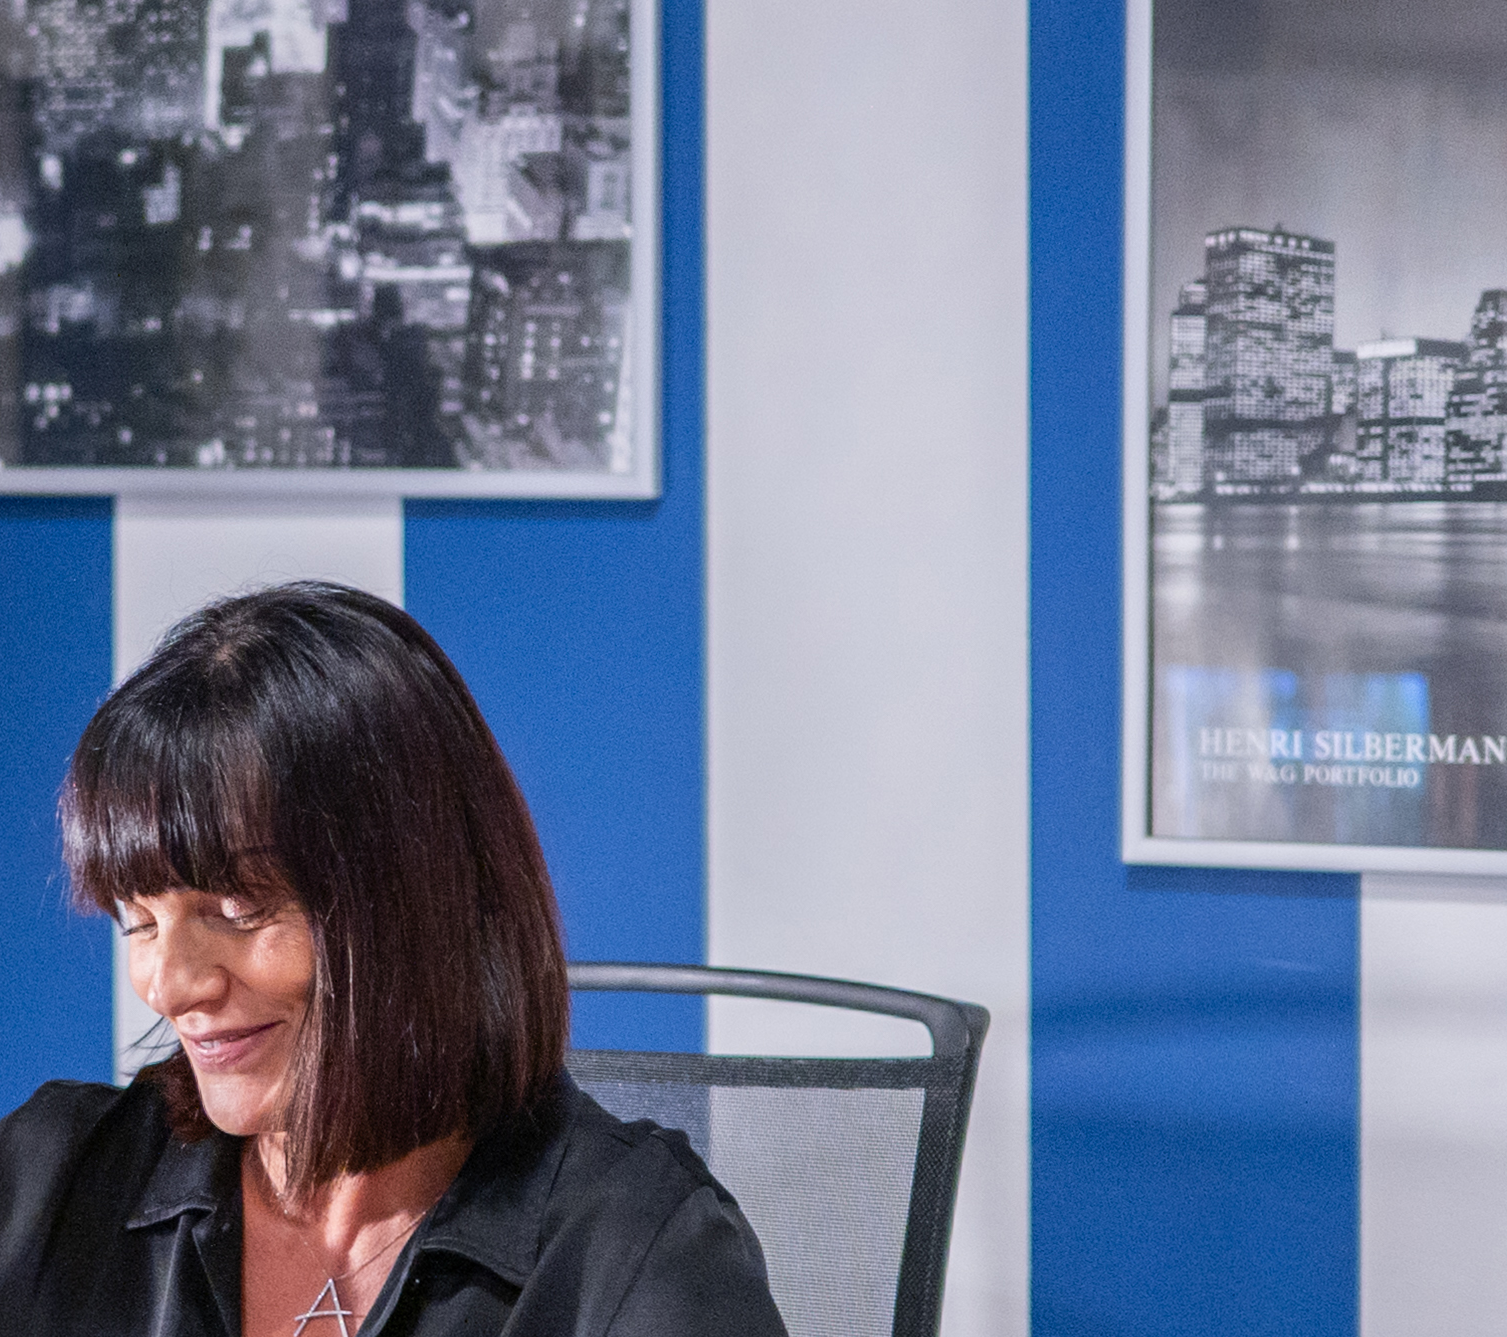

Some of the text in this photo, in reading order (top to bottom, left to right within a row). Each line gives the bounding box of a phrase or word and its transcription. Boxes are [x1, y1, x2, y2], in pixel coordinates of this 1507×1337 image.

[1199, 728, 1507, 764] HENRI SILBERMAN
[1201, 763, 1420, 788] THE W&G PORTFOLIO
